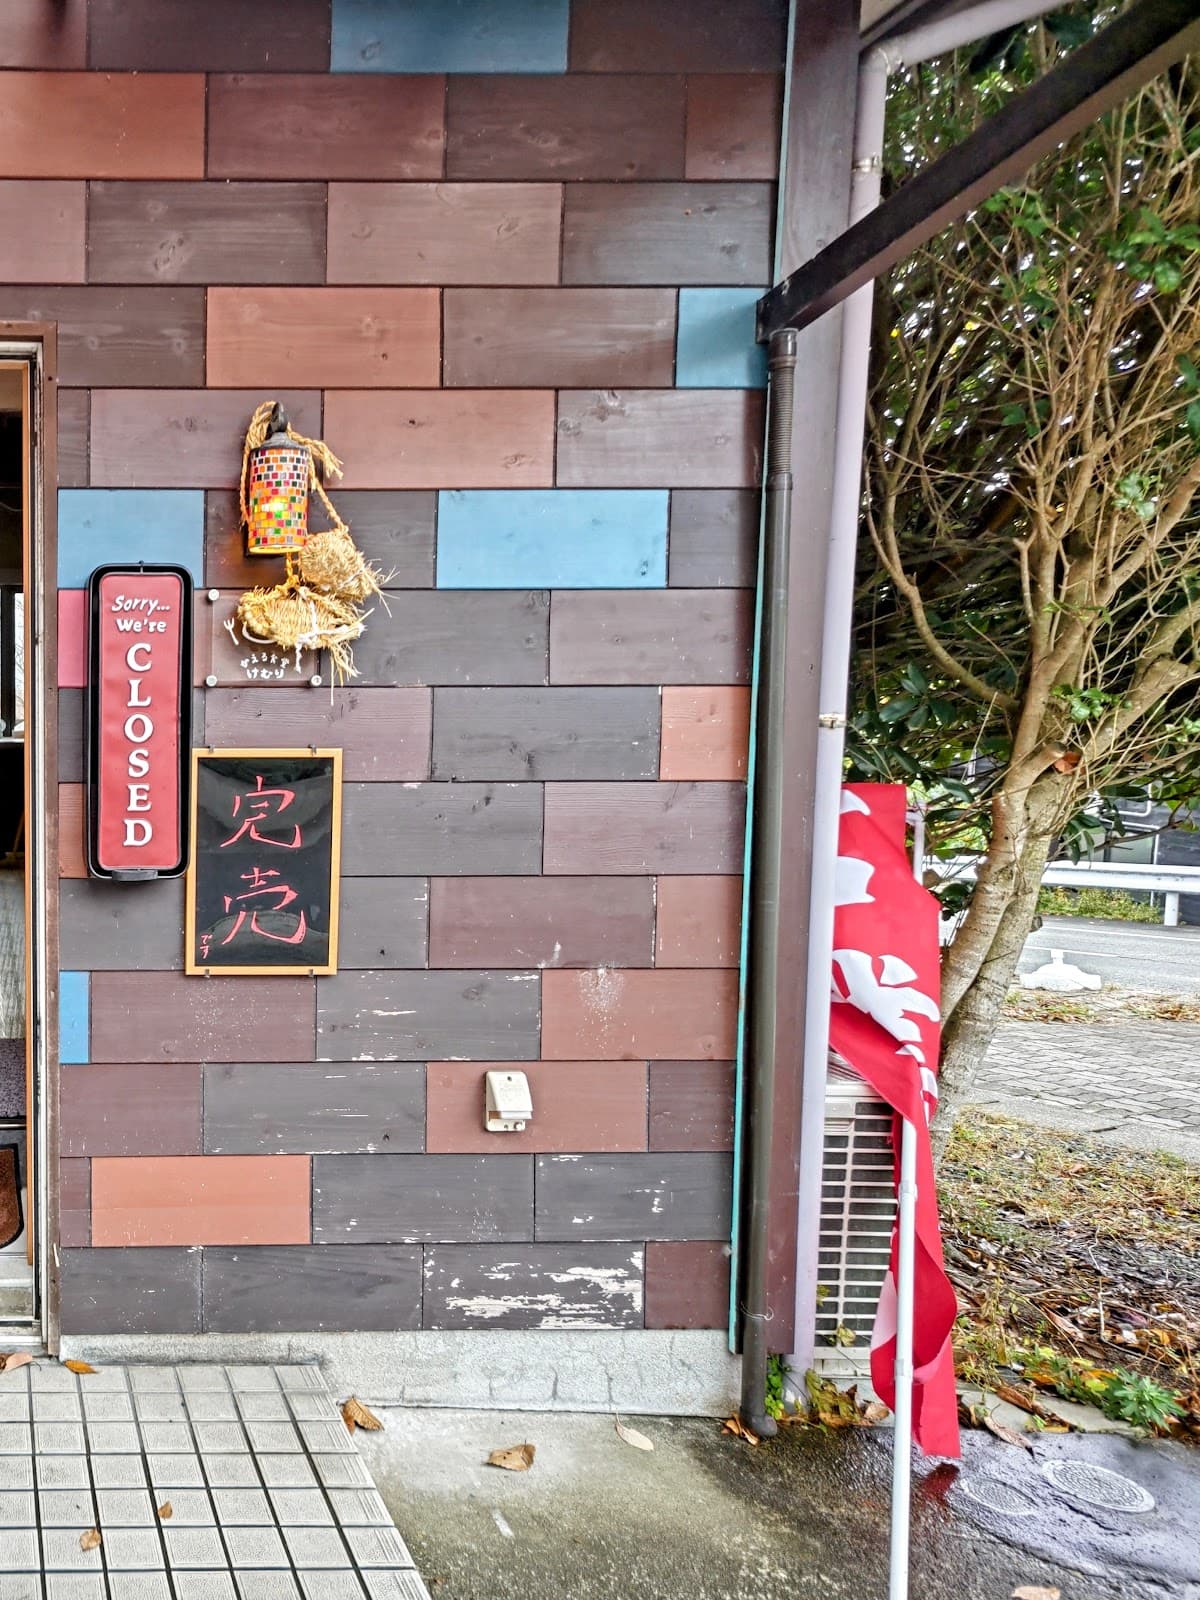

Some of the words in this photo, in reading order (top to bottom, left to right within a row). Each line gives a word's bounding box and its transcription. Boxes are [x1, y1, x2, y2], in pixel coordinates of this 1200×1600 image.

[112, 595, 170, 616] Sorry...
[116, 618, 167, 633] We're
[123, 642, 154, 847] CLOSED
[220, 775, 307, 945] 完売
